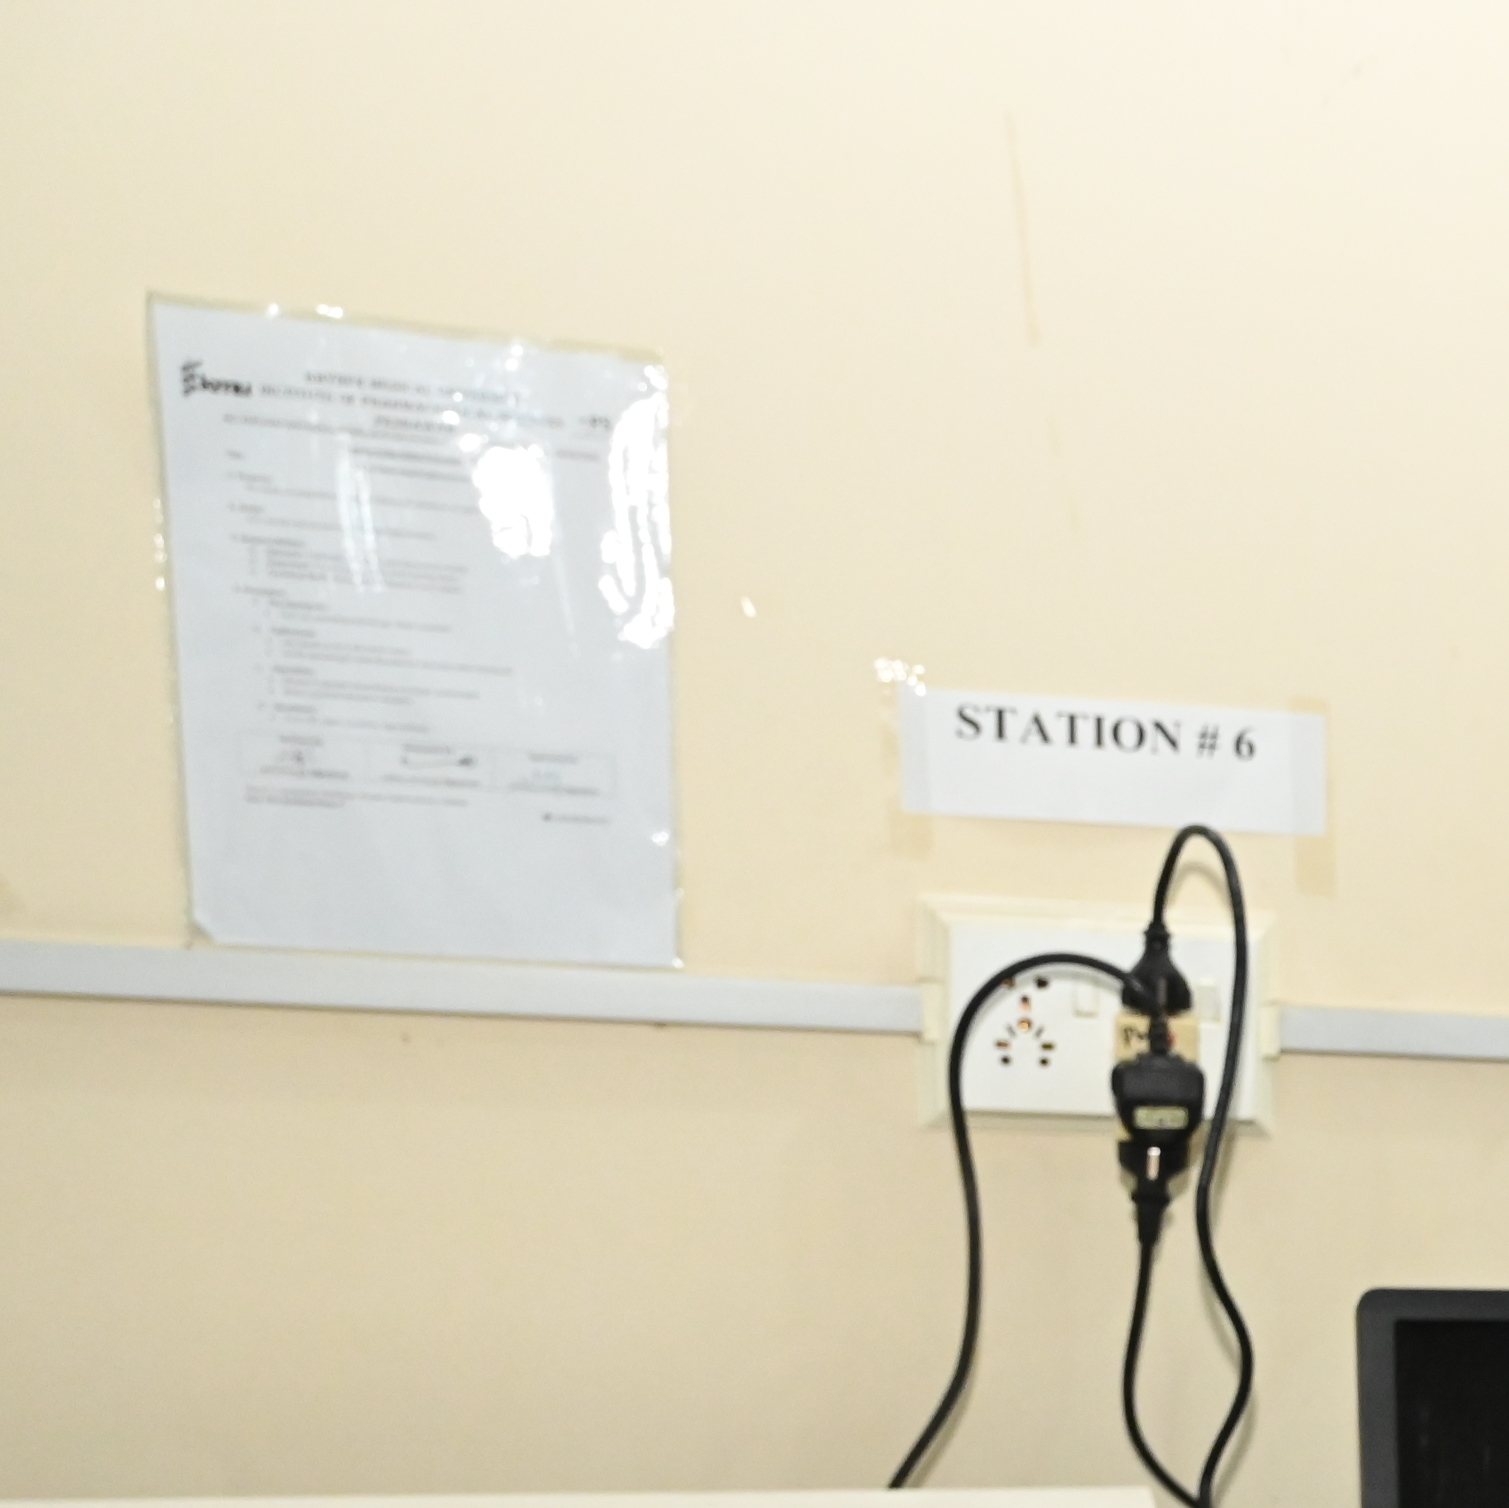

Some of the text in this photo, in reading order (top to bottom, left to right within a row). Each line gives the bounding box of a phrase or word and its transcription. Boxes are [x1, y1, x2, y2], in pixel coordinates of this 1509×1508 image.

[956, 702, 1257, 761] STATION # 6
